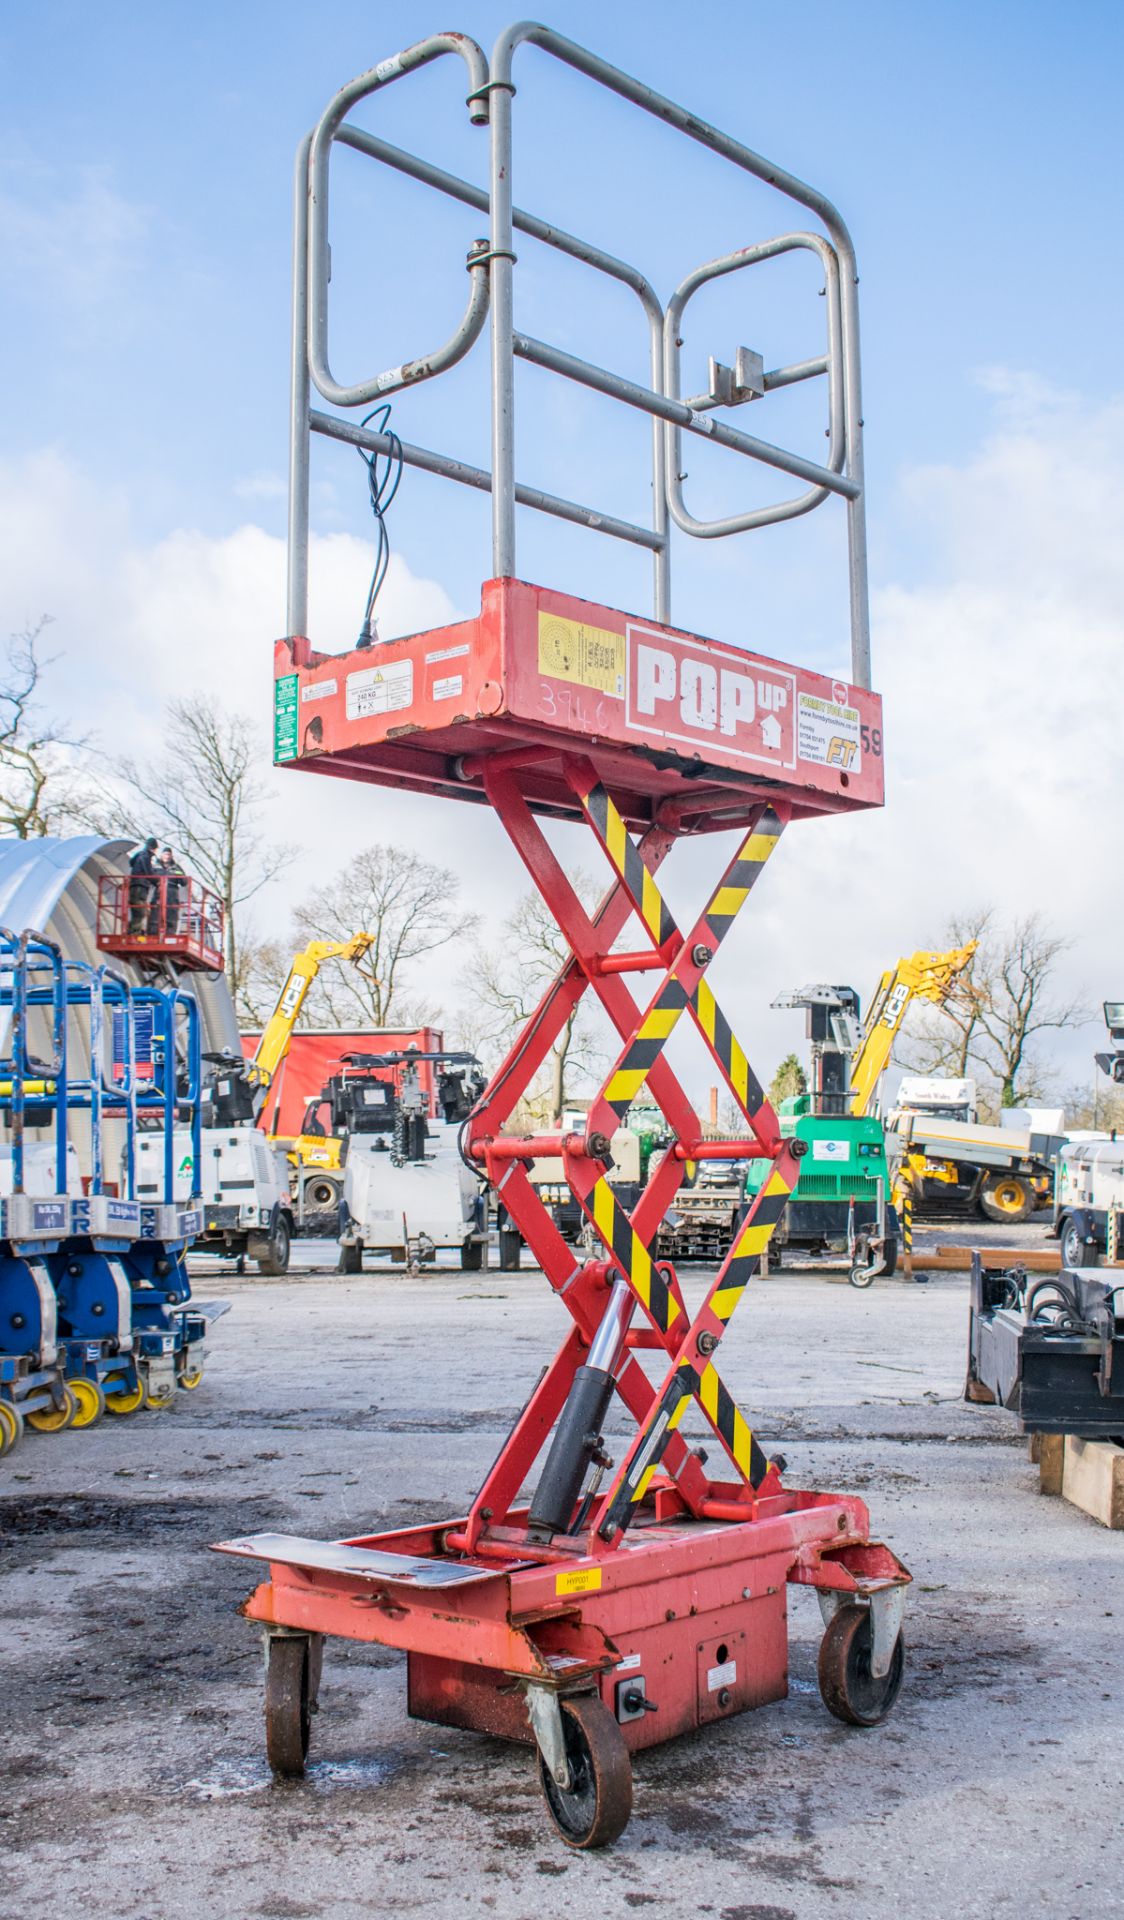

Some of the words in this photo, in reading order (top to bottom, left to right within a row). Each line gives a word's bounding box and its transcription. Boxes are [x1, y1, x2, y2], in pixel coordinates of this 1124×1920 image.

[637, 644, 756, 737] POP
[757, 680, 787, 713] UP
[860, 725, 882, 756] 59
[281, 974, 306, 1018] JCB
[883, 983, 909, 1029] JCB
